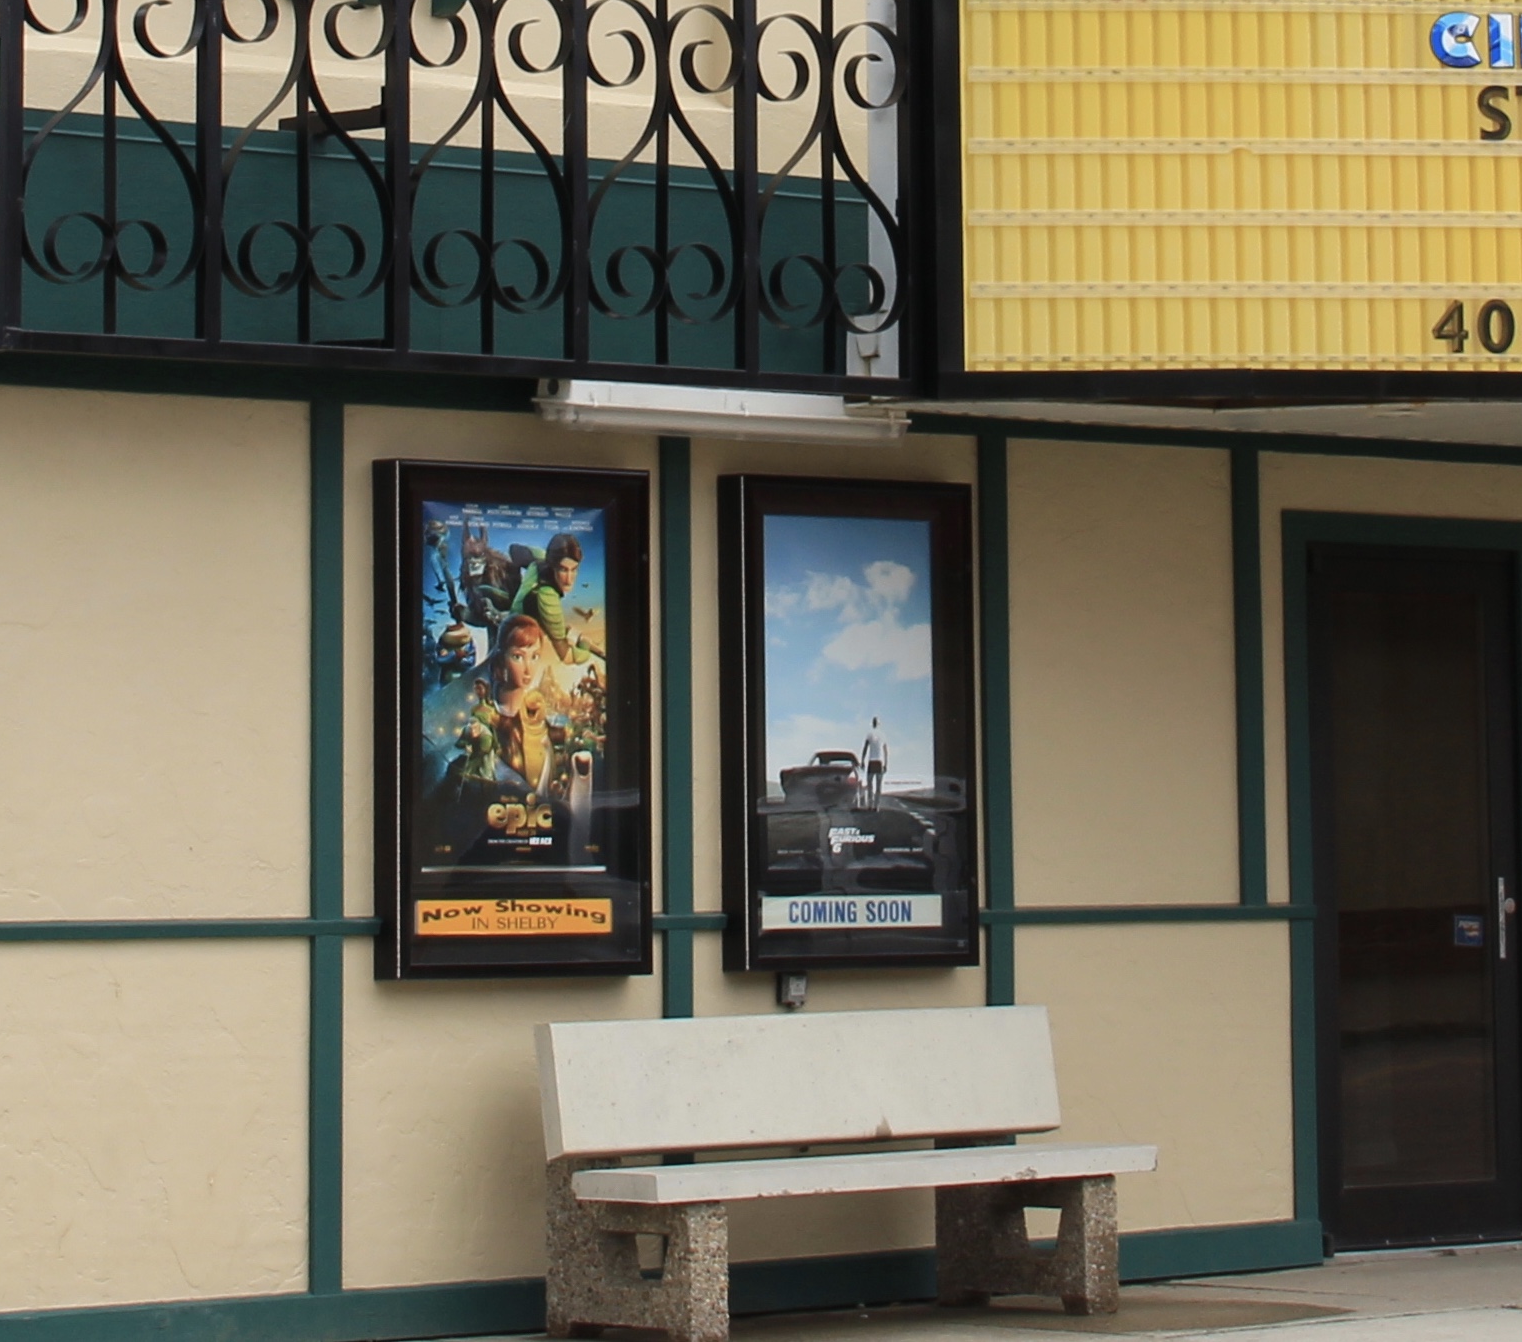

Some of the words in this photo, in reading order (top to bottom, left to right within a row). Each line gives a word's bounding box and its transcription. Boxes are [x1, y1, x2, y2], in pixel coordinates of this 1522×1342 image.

[486, 792, 553, 835] epic
[828, 828, 855, 838] FAST
[830, 835, 875, 845] FURIOUS
[422, 905, 483, 923] Now
[495, 899, 607, 924] Showing
[789, 901, 857, 923] COMING
[866, 900, 912, 922] SOON
[472, 917, 489, 929] IN
[497, 917, 558, 930] SHELBY
